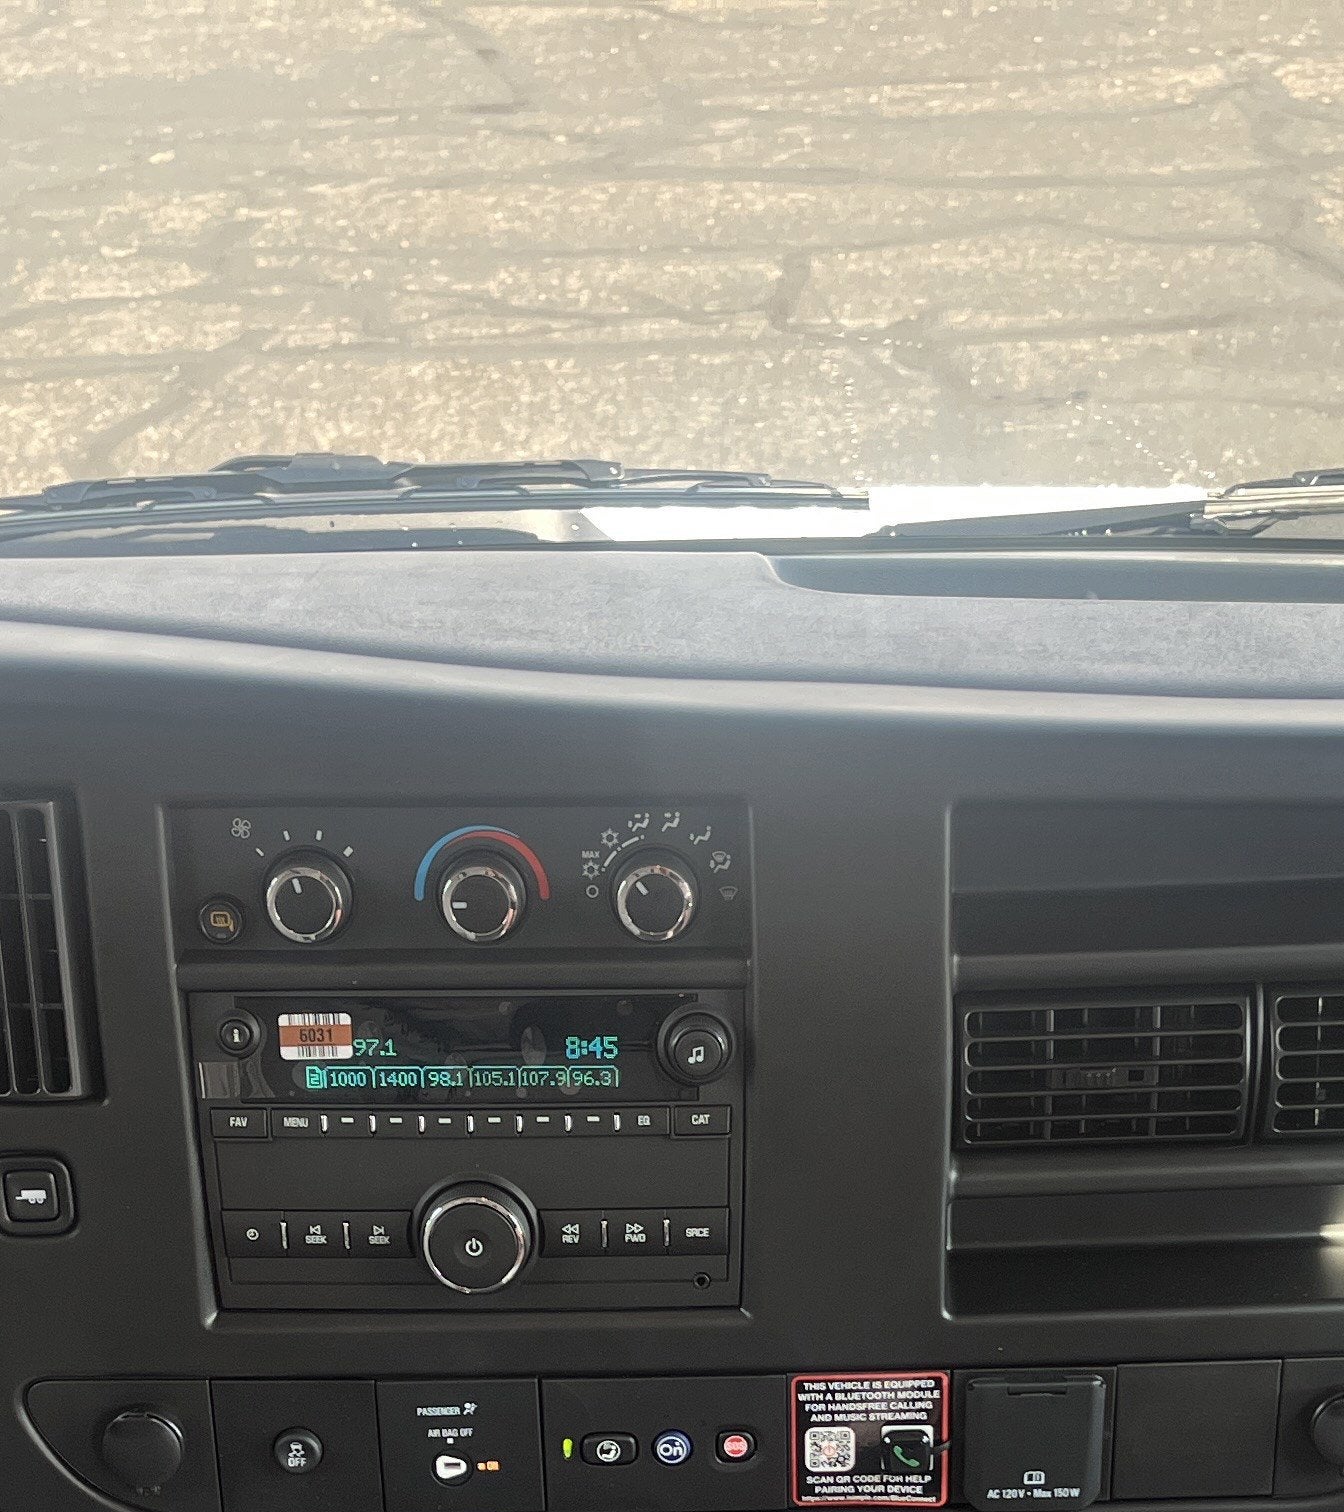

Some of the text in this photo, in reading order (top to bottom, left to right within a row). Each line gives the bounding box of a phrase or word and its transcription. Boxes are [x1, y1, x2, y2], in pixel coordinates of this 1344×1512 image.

[581, 850, 600, 858] MAX
[299, 1028, 333, 1043] 6031
[353, 1038, 397, 1056] 97.1
[565, 1036, 618, 1059] 8:45
[330, 1072, 367, 1087] 1000
[379, 1071, 418, 1087] 1400
[427, 1071, 464, 1087] 98.1
[474, 1071, 515, 1087] 105.1
[521, 1071, 567, 1086] 107.9
[572, 1071, 611, 1086] 96.3
[229, 1117, 248, 1127] FAV
[283, 1117, 309, 1128] MENU
[638, 1115, 651, 1126] EQ
[691, 1114, 710, 1125] CAT
[685, 1227, 710, 1238] SRCE
[306, 1235, 327, 1244] SEEK
[368, 1235, 390, 1245] SEEK
[561, 1234, 580, 1244] REV
[624, 1233, 646, 1243] FWD
[803, 1380, 935, 1391] THIS VEHICLE IS EQUIPPED
[798, 1390, 940, 1401] WITH A BLUETOOTH MODULE
[416, 1406, 461, 1416] PASSENGER
[805, 1401, 933, 1412] FOR HANDSFREE CALLING
[810, 1411, 927, 1422] AND MUSIC STREAMING
[427, 1428, 473, 1438] AIR BAG OFF
[288, 1457, 306, 1467] OFF
[806, 1474, 932, 1484] SCAN QR CODE FOR HELP
[815, 1485, 923, 1494] PAIRING YOUR DEVICE
[986, 1489, 1000, 1499] AC
[1032, 1489, 1052, 1498] Max
